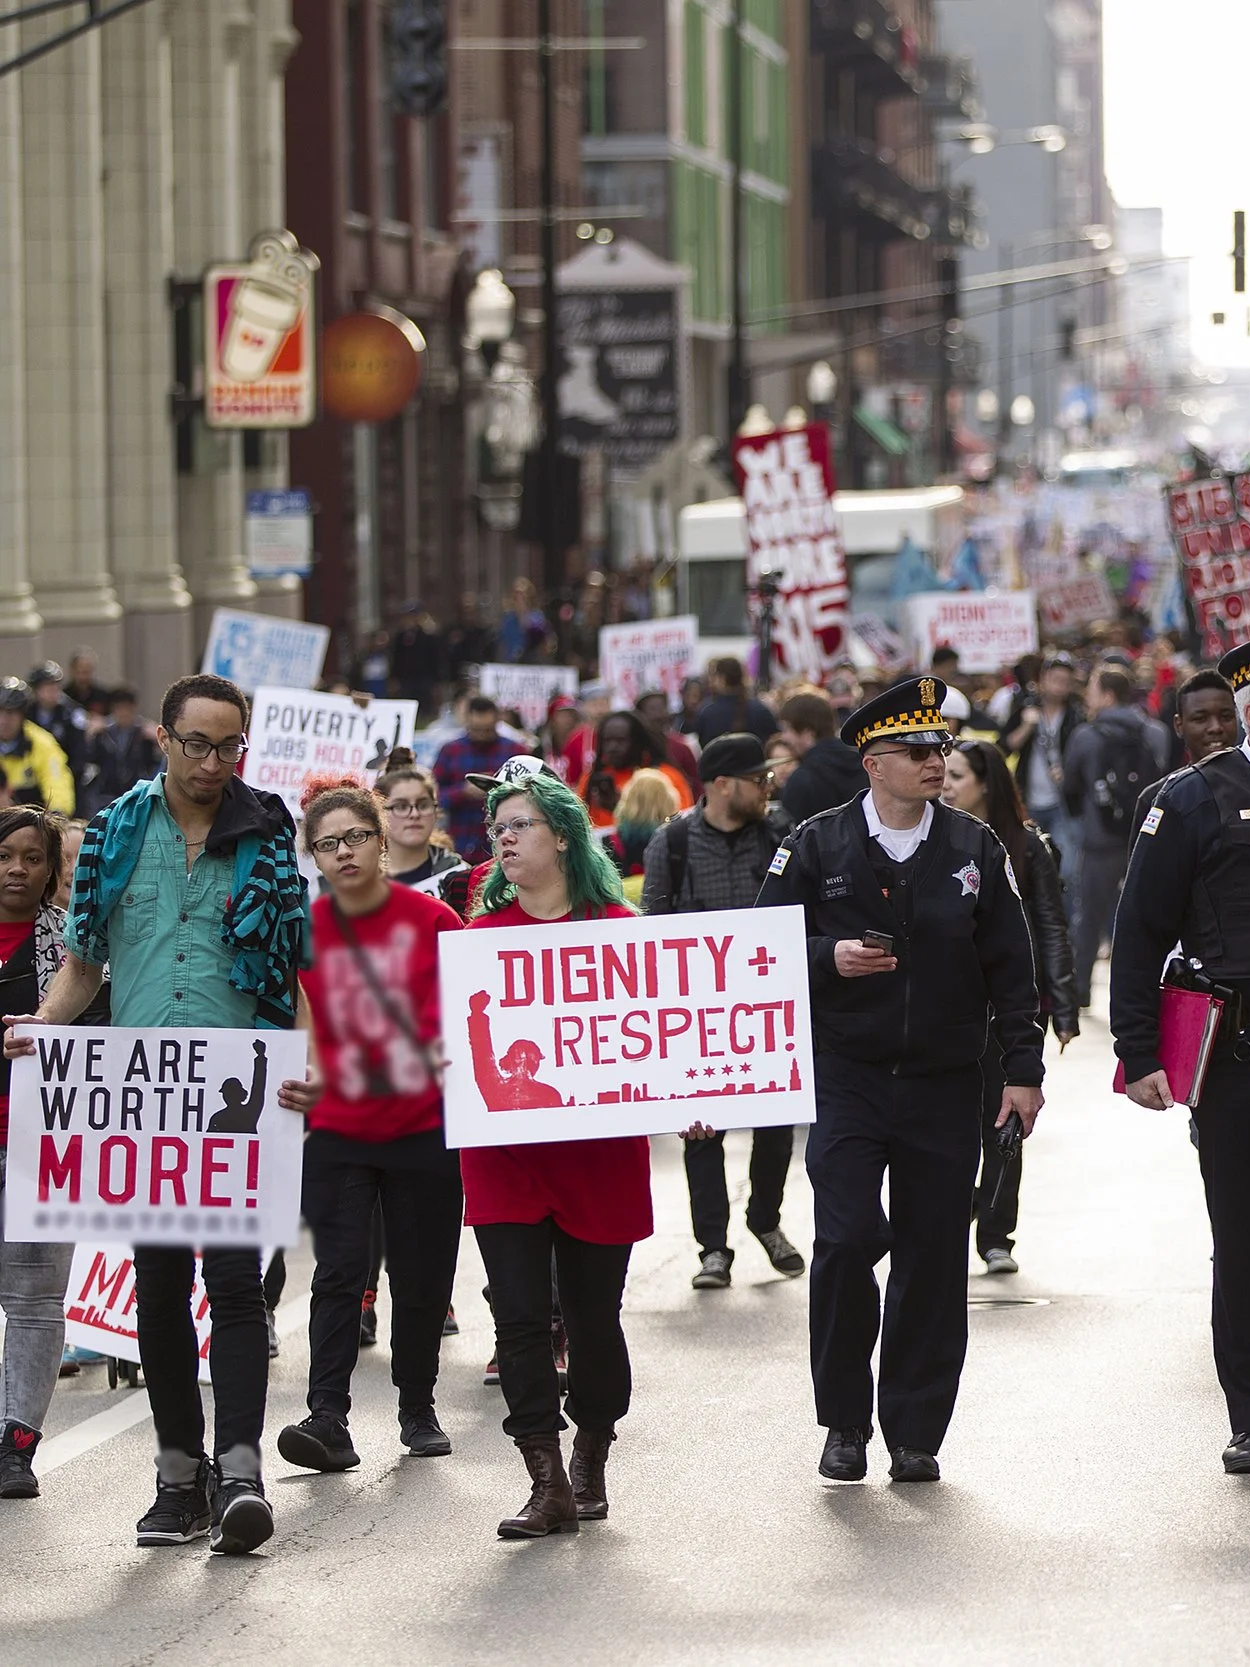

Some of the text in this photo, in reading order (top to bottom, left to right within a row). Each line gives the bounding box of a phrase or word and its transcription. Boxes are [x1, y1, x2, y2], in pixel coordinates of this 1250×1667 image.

[737, 432, 810, 475] WE
[264, 703, 377, 741] POVERTY
[259, 736, 365, 768] JOBS HOLD
[497, 935, 777, 1008] DIGNITY +
[551, 1000, 796, 1068] RESPECT!
[38, 1037, 208, 1083] WE ARE
[40, 1086, 204, 1132] WORTH
[37, 1134, 261, 1209] MORE!
